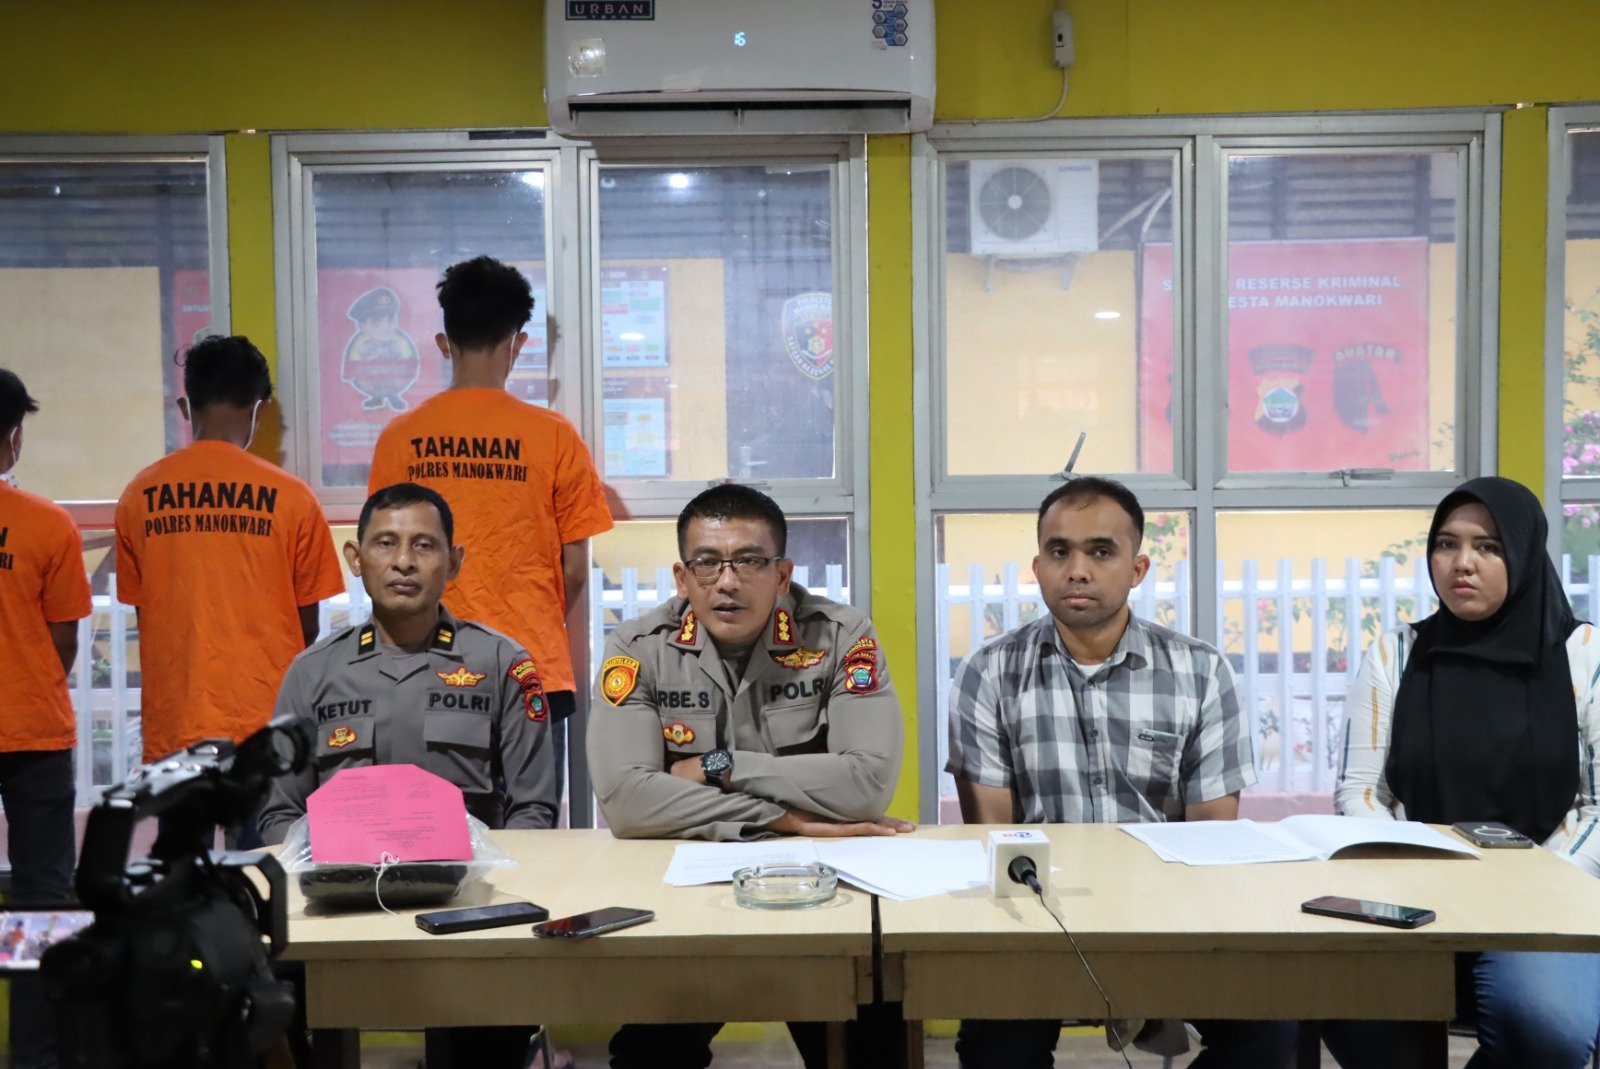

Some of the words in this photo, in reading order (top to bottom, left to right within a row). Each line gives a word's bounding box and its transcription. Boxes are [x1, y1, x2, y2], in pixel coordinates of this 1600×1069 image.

[575, 4, 643, 14] URBAN
[1236, 277, 1312, 290] RESERSE
[1319, 275, 1402, 289] KRIMINAL
[1228, 296, 1269, 308] ESTA
[1275, 293, 1383, 307] MANOKWARI
[411, 436, 521, 461] TAHANAN
[408, 461, 449, 481] POLRES
[452, 462, 528, 482] MANOKWARI
[143, 482, 278, 514] TAHANAN
[144, 514, 191, 537] POLRES
[195, 514, 273, 537] MANOKWARI
[317, 699, 373, 723] KETUT
[429, 692, 490, 712] POLRI
